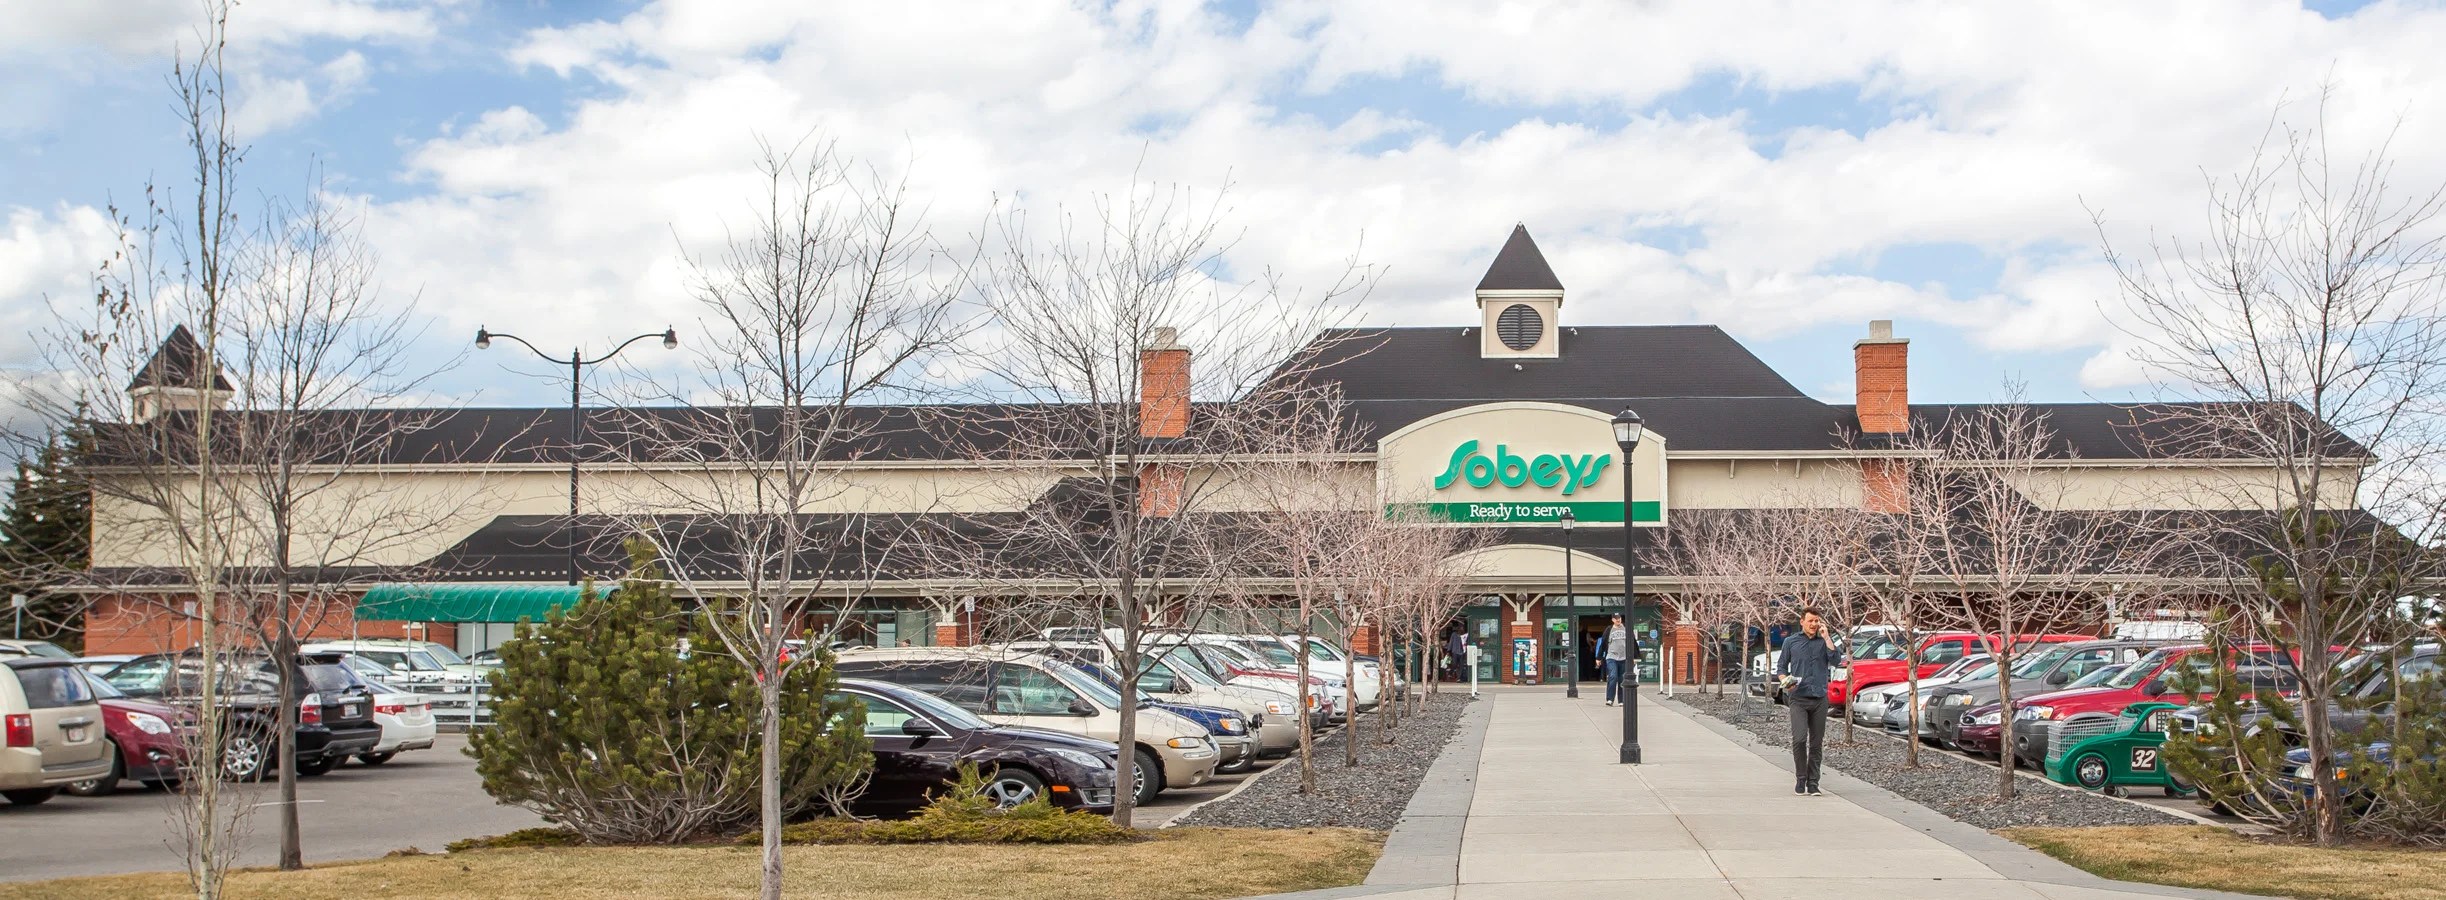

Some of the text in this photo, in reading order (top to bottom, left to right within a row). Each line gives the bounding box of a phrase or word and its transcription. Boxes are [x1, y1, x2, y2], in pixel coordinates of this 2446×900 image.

[1435, 439, 1611, 495] Sobeys
[1470, 503, 1513, 521] Ready
[1516, 504, 1531, 517] to
[2132, 749, 2156, 768] 32
